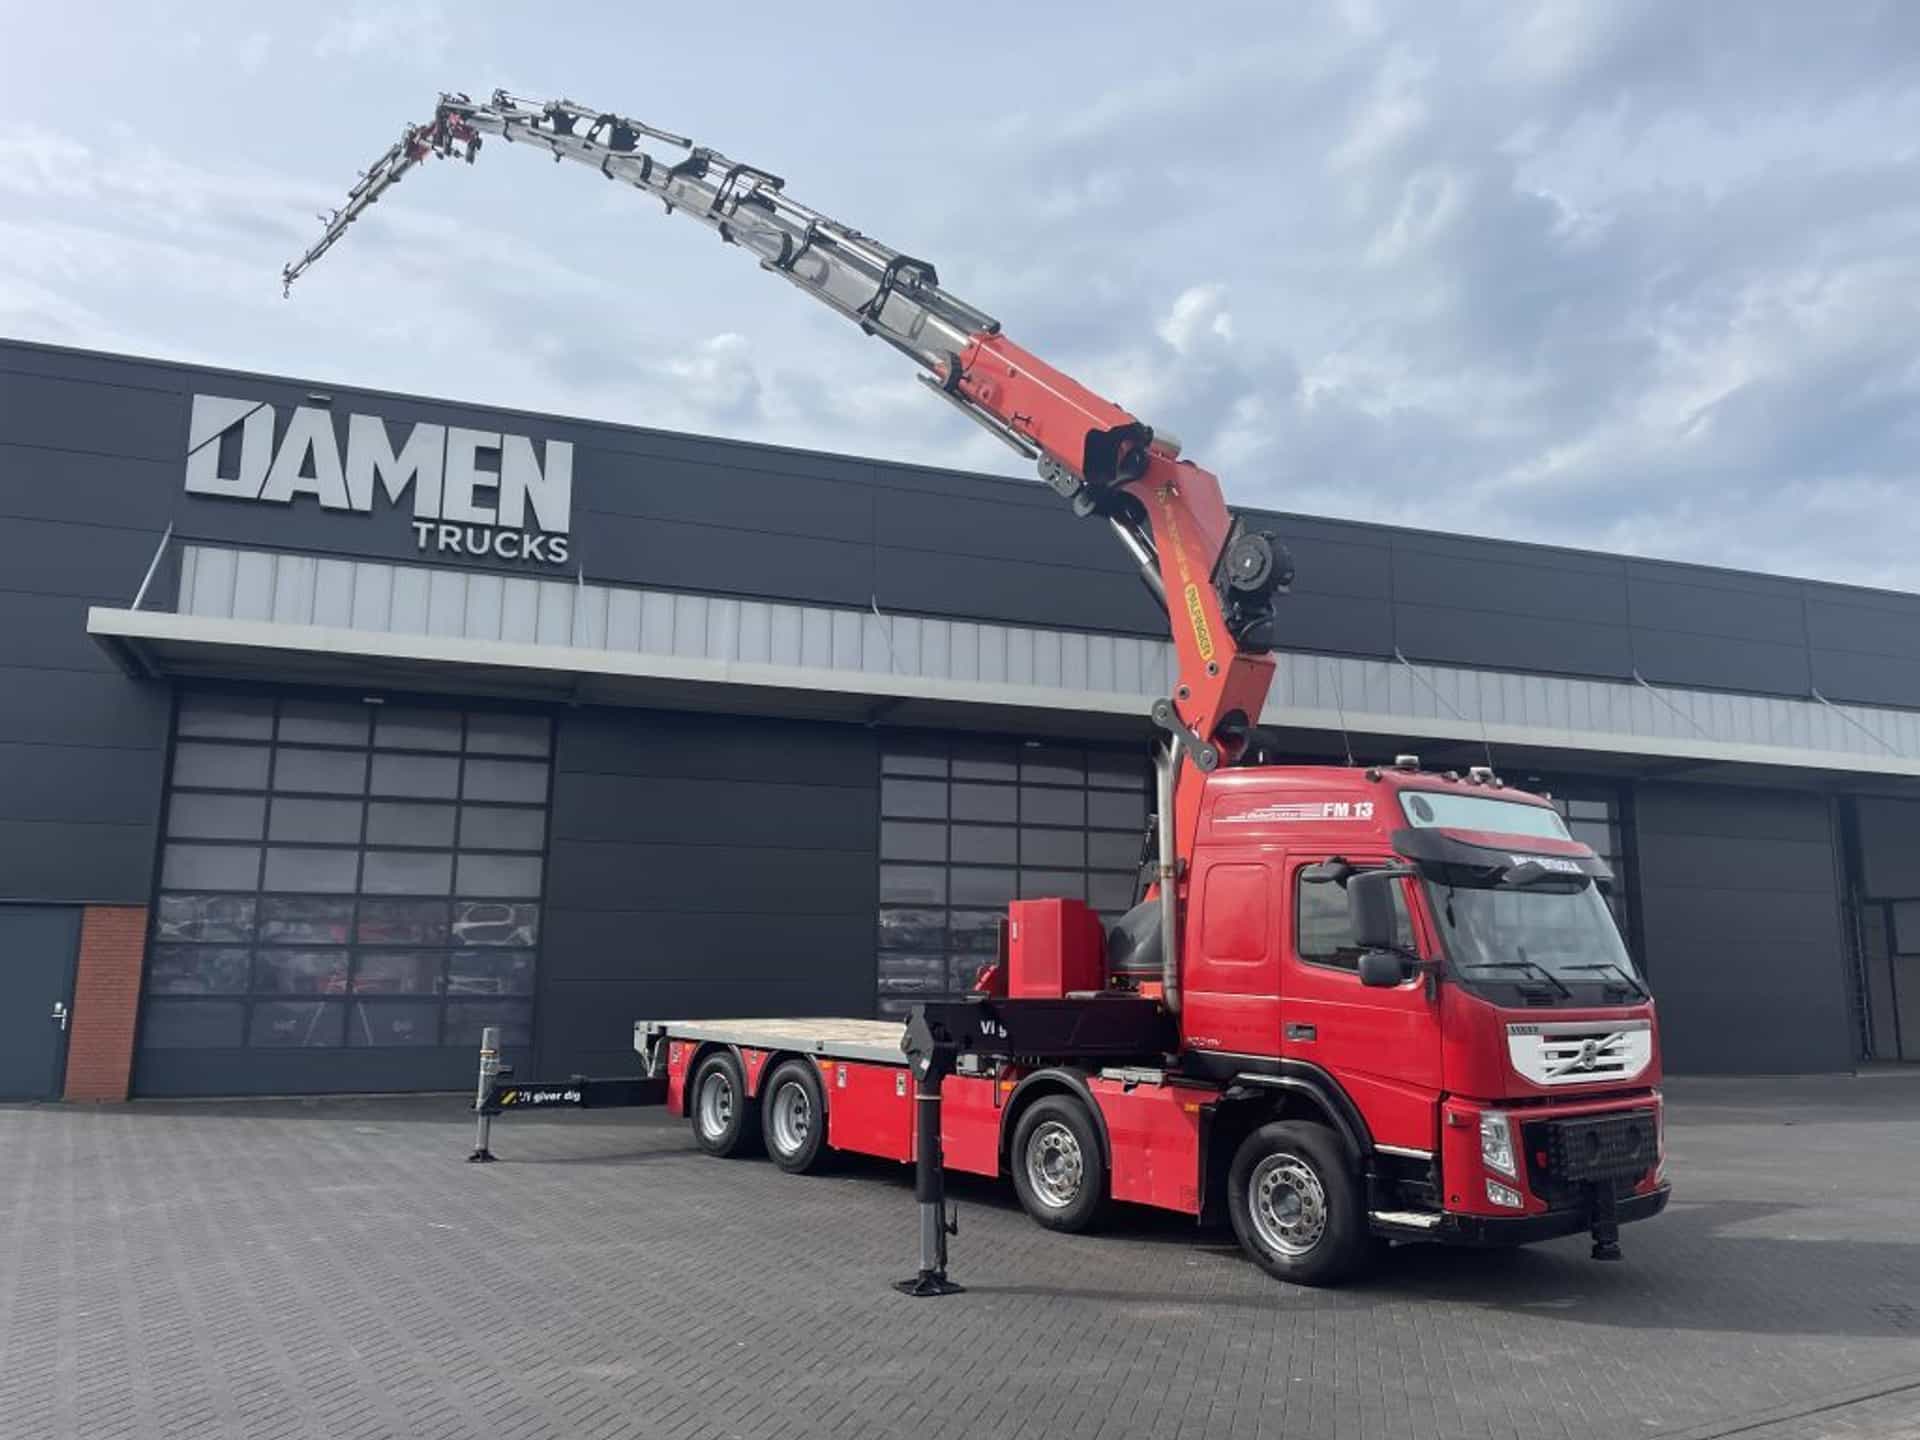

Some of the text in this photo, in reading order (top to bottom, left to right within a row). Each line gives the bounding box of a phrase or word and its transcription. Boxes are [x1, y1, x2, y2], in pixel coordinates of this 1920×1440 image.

[185, 394, 574, 533] DAMEN
[412, 521, 569, 563] TRUCKS
[1322, 801, 1373, 817] FM 13
